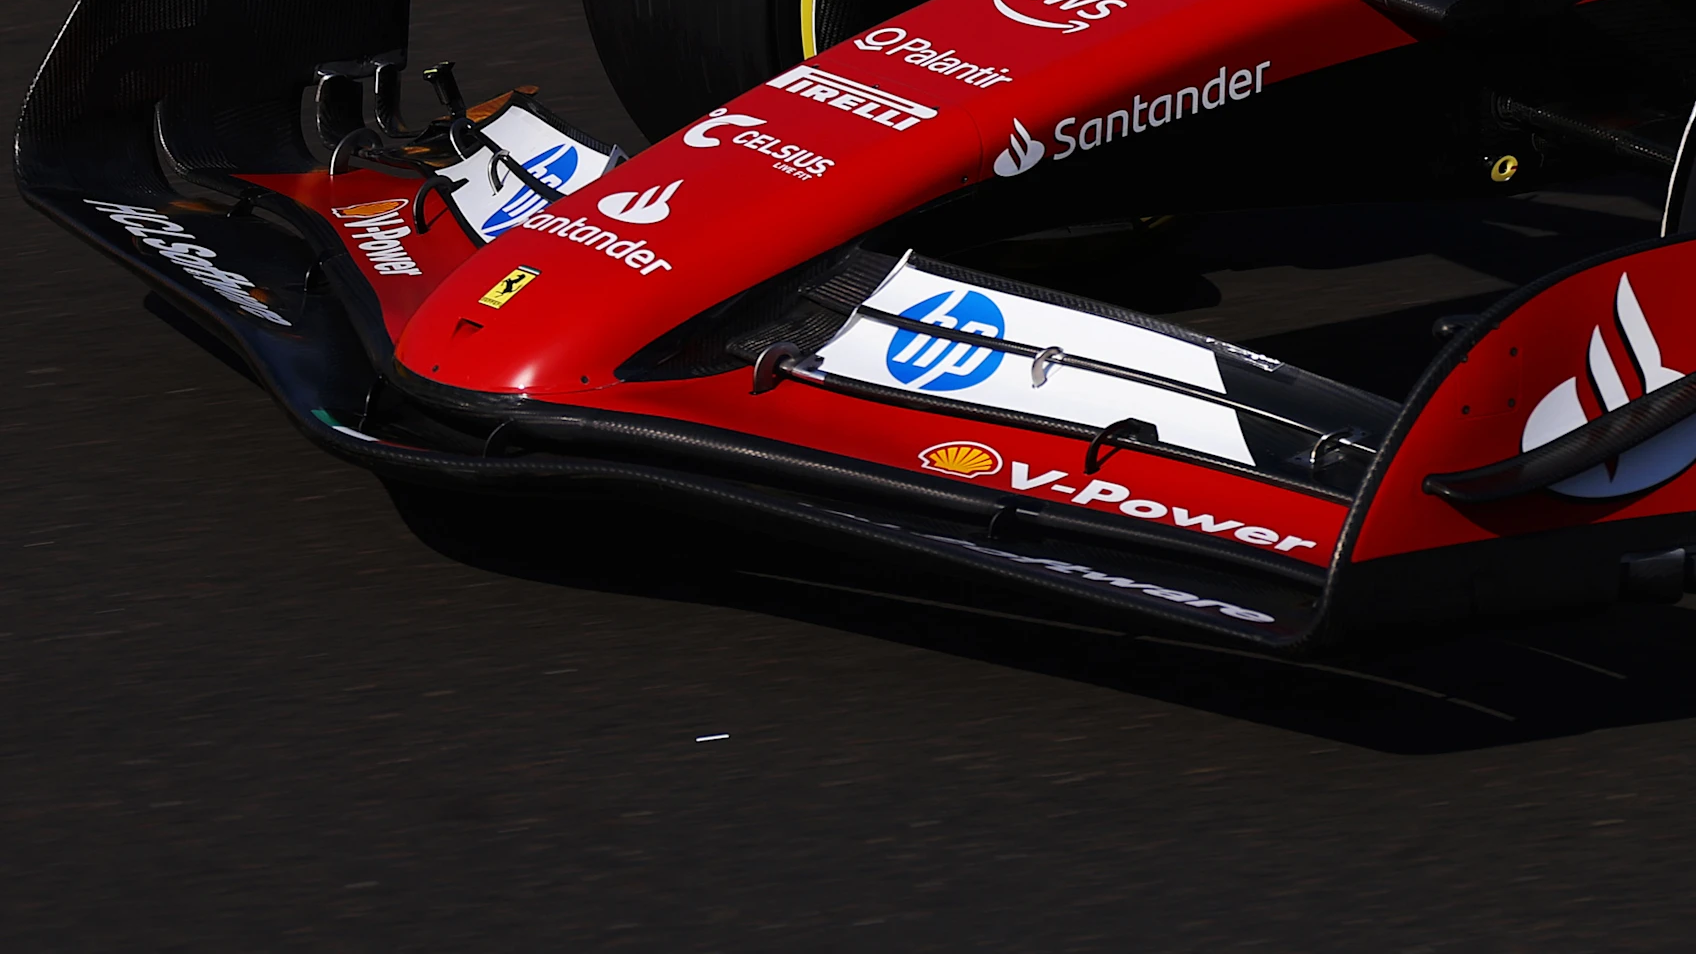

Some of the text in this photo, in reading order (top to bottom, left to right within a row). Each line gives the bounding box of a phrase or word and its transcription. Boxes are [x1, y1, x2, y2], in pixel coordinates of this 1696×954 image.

[885, 37, 1012, 88] Palantir
[765, 65, 938, 131] PIRELLI
[1053, 60, 1271, 161] Santander
[772, 161, 812, 182] LIVE FIT
[344, 212, 422, 276] V-Power
[892, 290, 1002, 391] hp
[1010, 460, 1316, 552] V-Power
